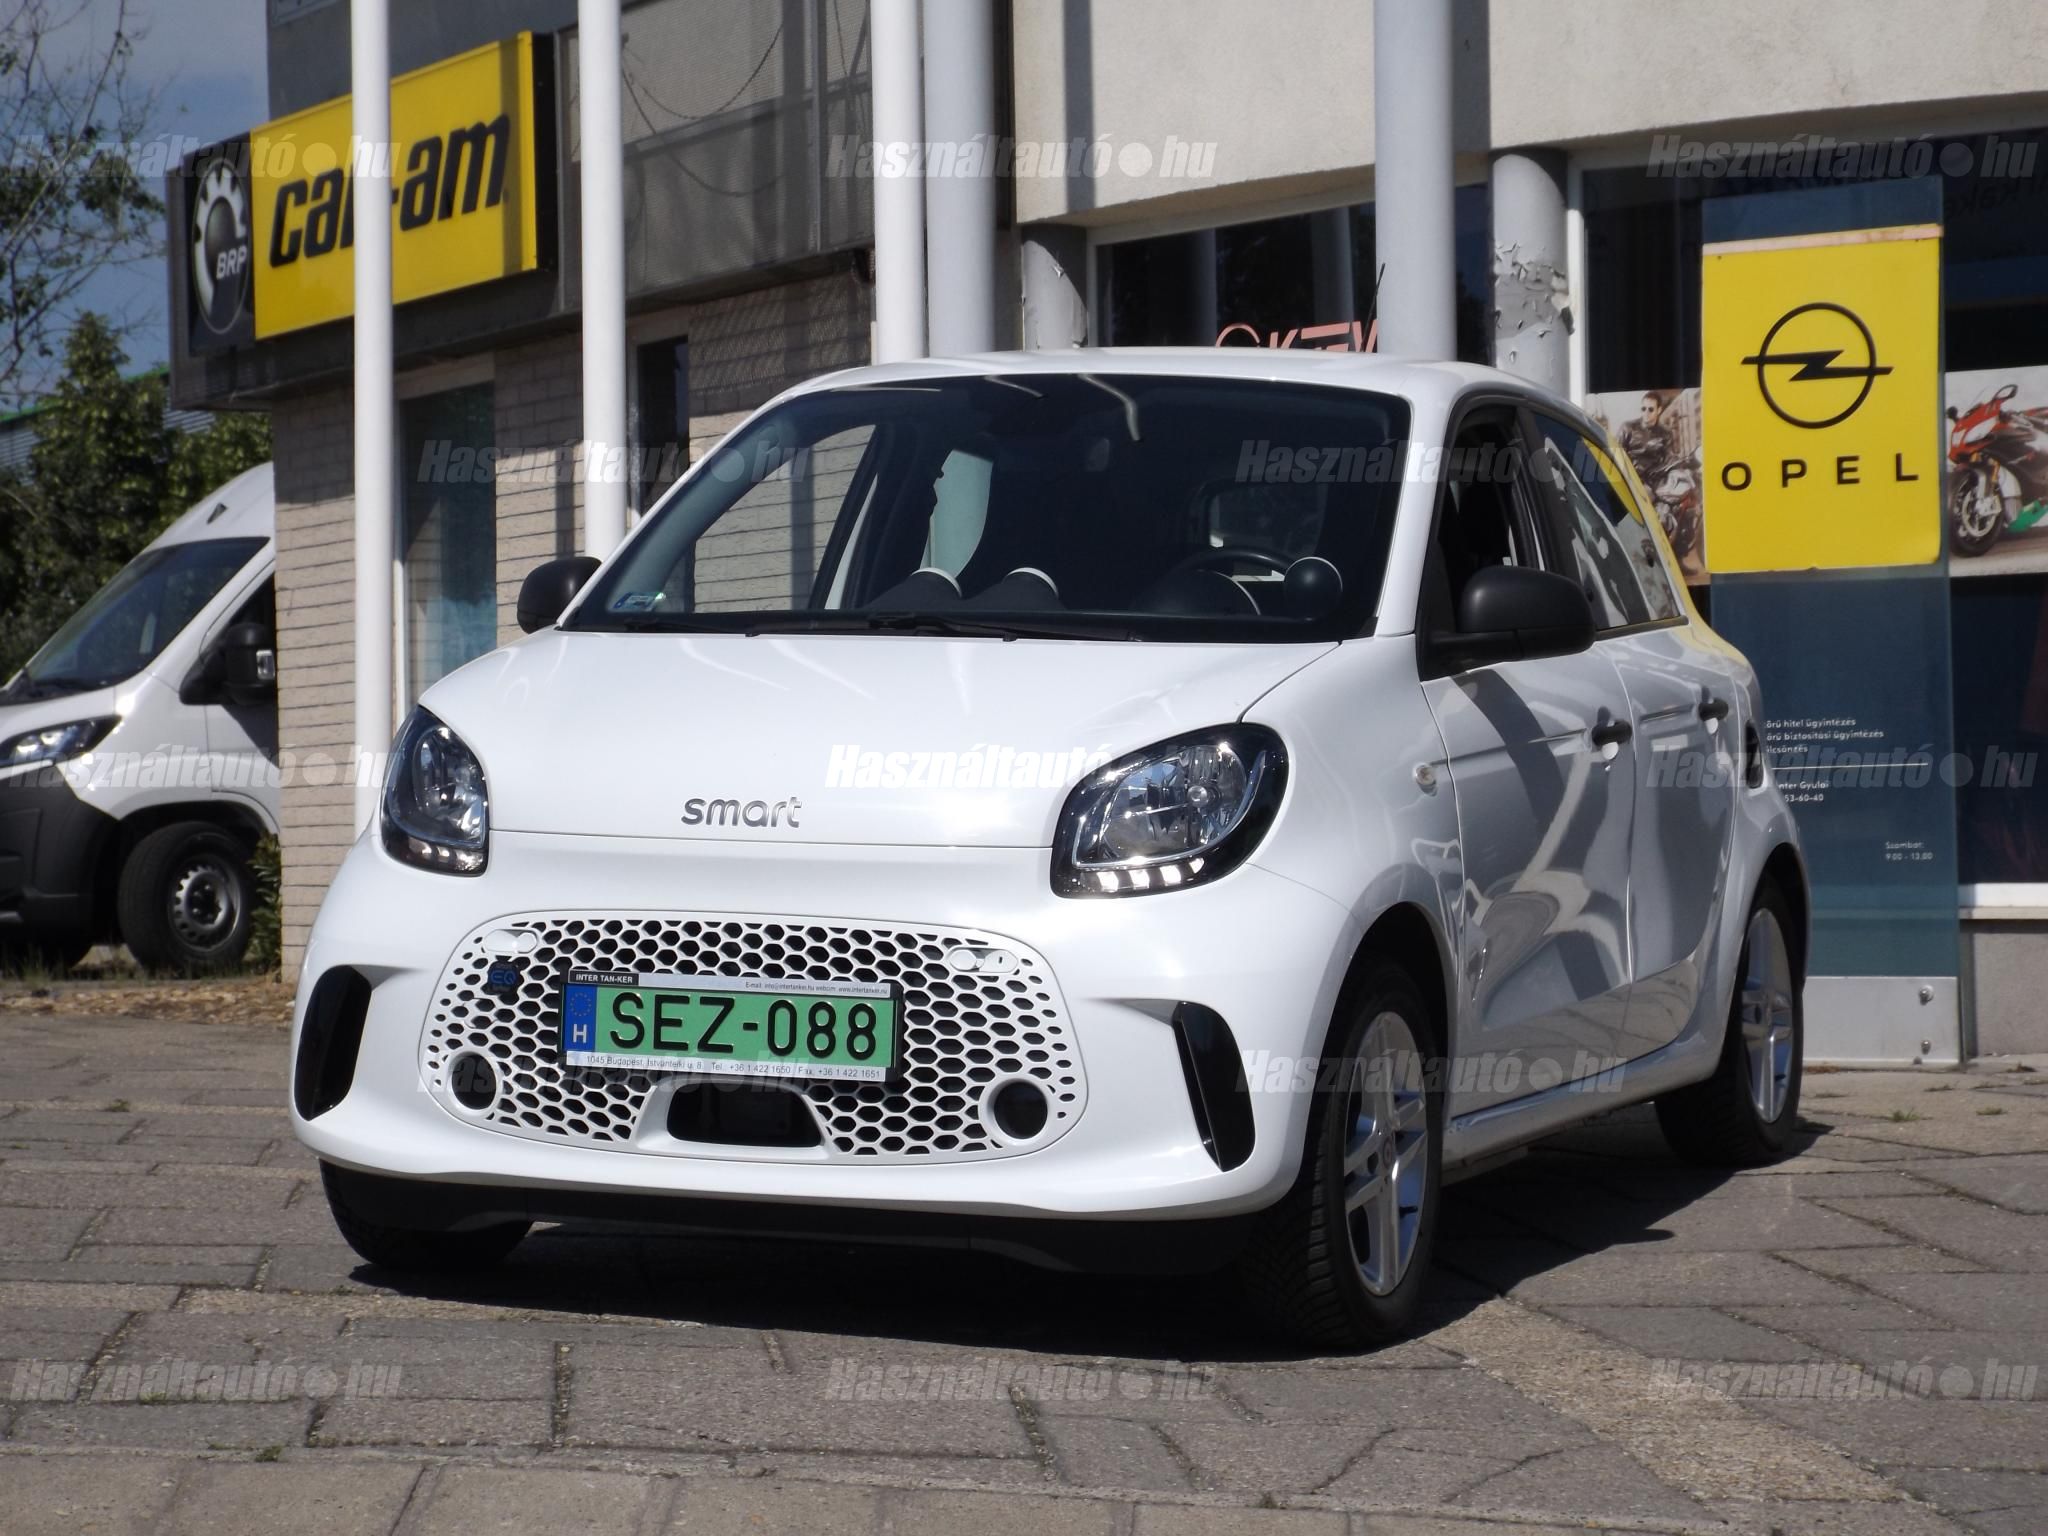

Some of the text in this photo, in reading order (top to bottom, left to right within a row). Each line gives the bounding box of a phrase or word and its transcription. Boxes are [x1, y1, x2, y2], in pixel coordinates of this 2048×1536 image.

[216, 245, 247, 280] BRP
[1721, 452, 1919, 491] OPEL
[1783, 719, 1804, 728] hitel
[681, 797, 801, 828] smart
[575, 973, 633, 984] INTER TAN-KER
[572, 1023, 588, 1044] H
[609, 992, 877, 1061] SEZ-088
[586, 1055, 605, 1064] 1045
[729, 1063, 745, 1072] +36
[753, 1064, 769, 1073] 422
[771, 1066, 791, 1074] 1650
[818, 1068, 833, 1077] +36
[842, 1069, 858, 1078] 422
[861, 1070, 881, 1079] 1651
